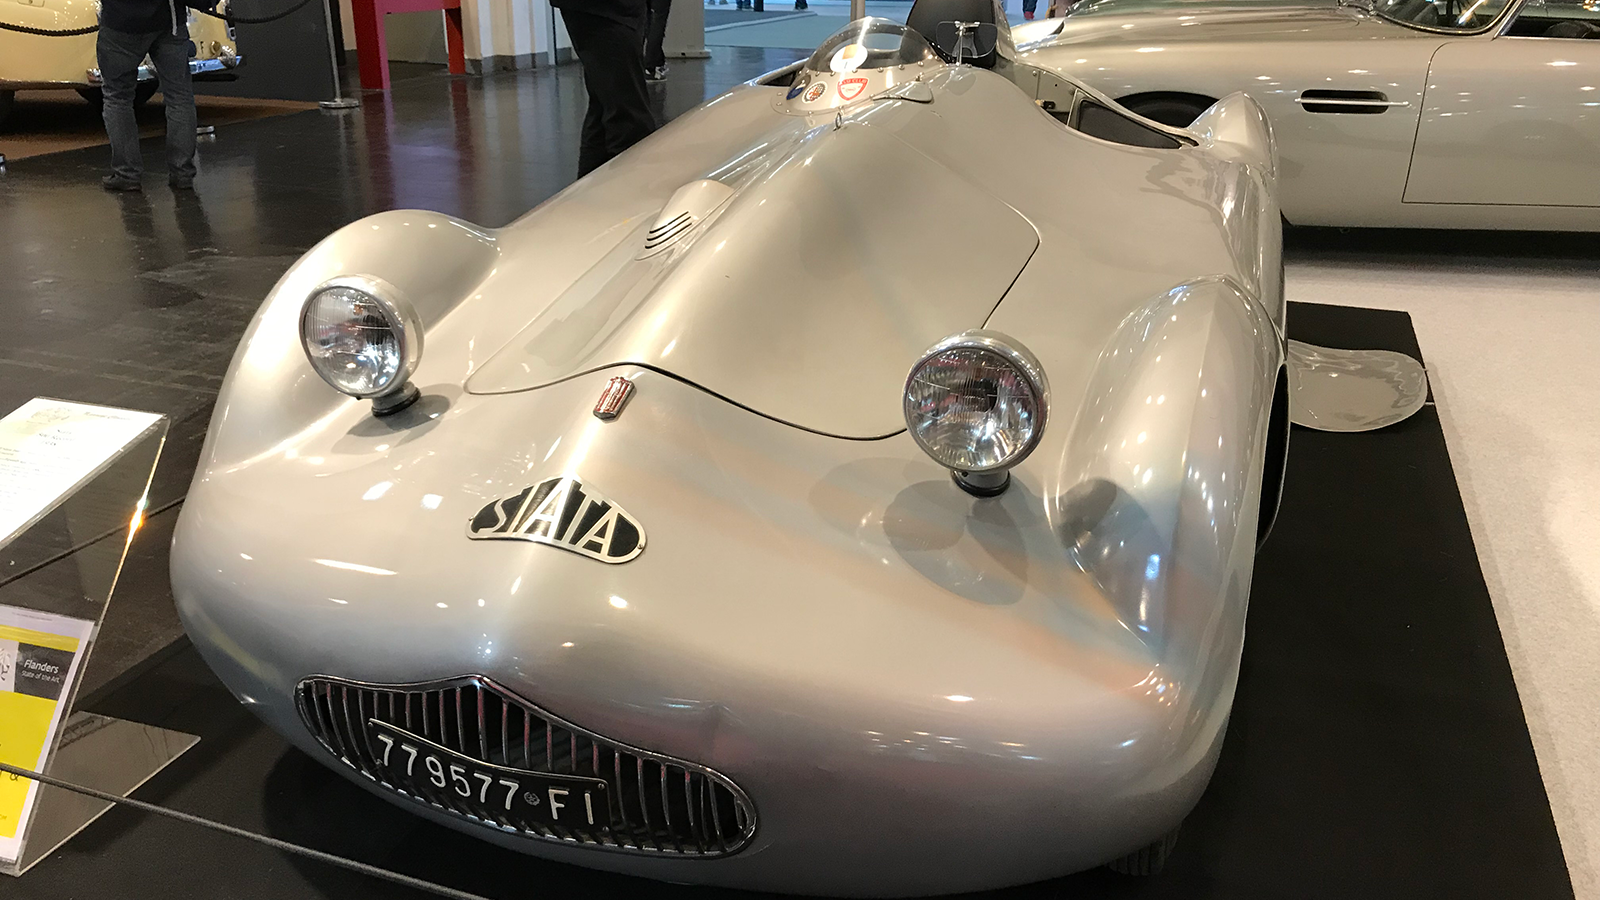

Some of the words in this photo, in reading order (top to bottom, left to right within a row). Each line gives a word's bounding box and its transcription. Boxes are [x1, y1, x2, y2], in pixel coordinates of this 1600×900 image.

[475, 477, 615, 558] SIATA
[24, 659, 59, 674] Flanders
[376, 732, 521, 811] 779577
